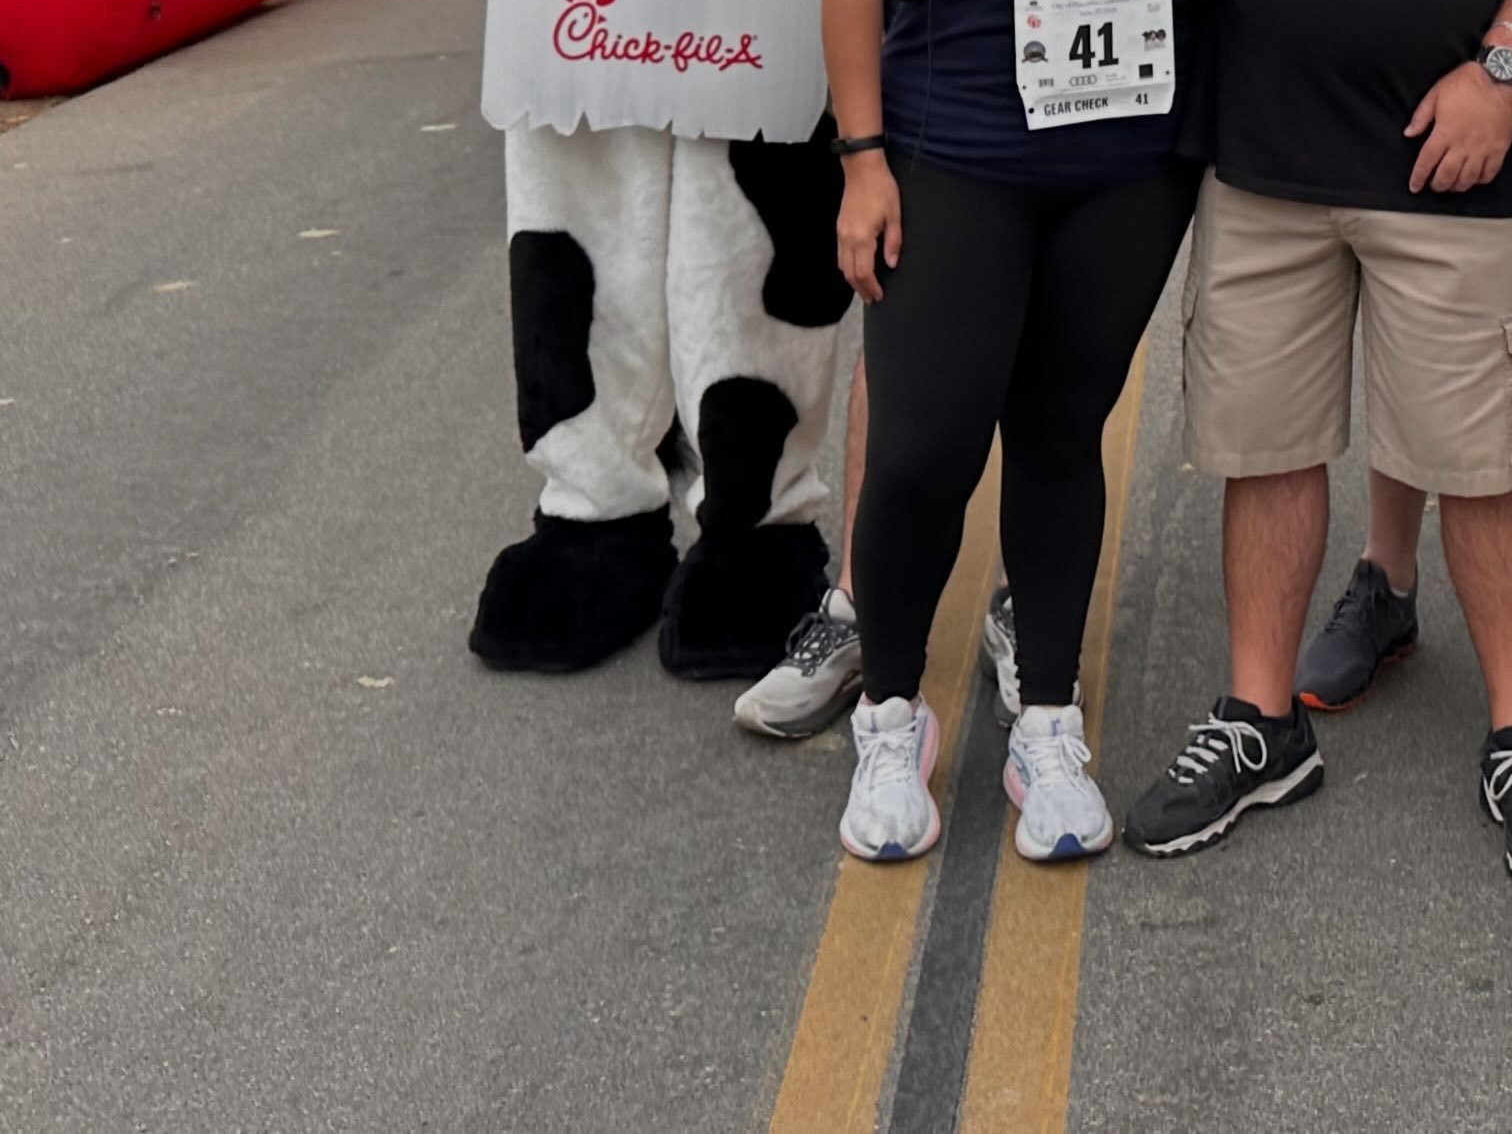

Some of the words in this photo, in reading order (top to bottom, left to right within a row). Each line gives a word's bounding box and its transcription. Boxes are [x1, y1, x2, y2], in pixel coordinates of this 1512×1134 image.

[1069, 22, 1119, 69] 41
[1044, 100, 1071, 116] GEAR
[1074, 97, 1109, 112] CHECK
[1135, 93, 1150, 106] 41
